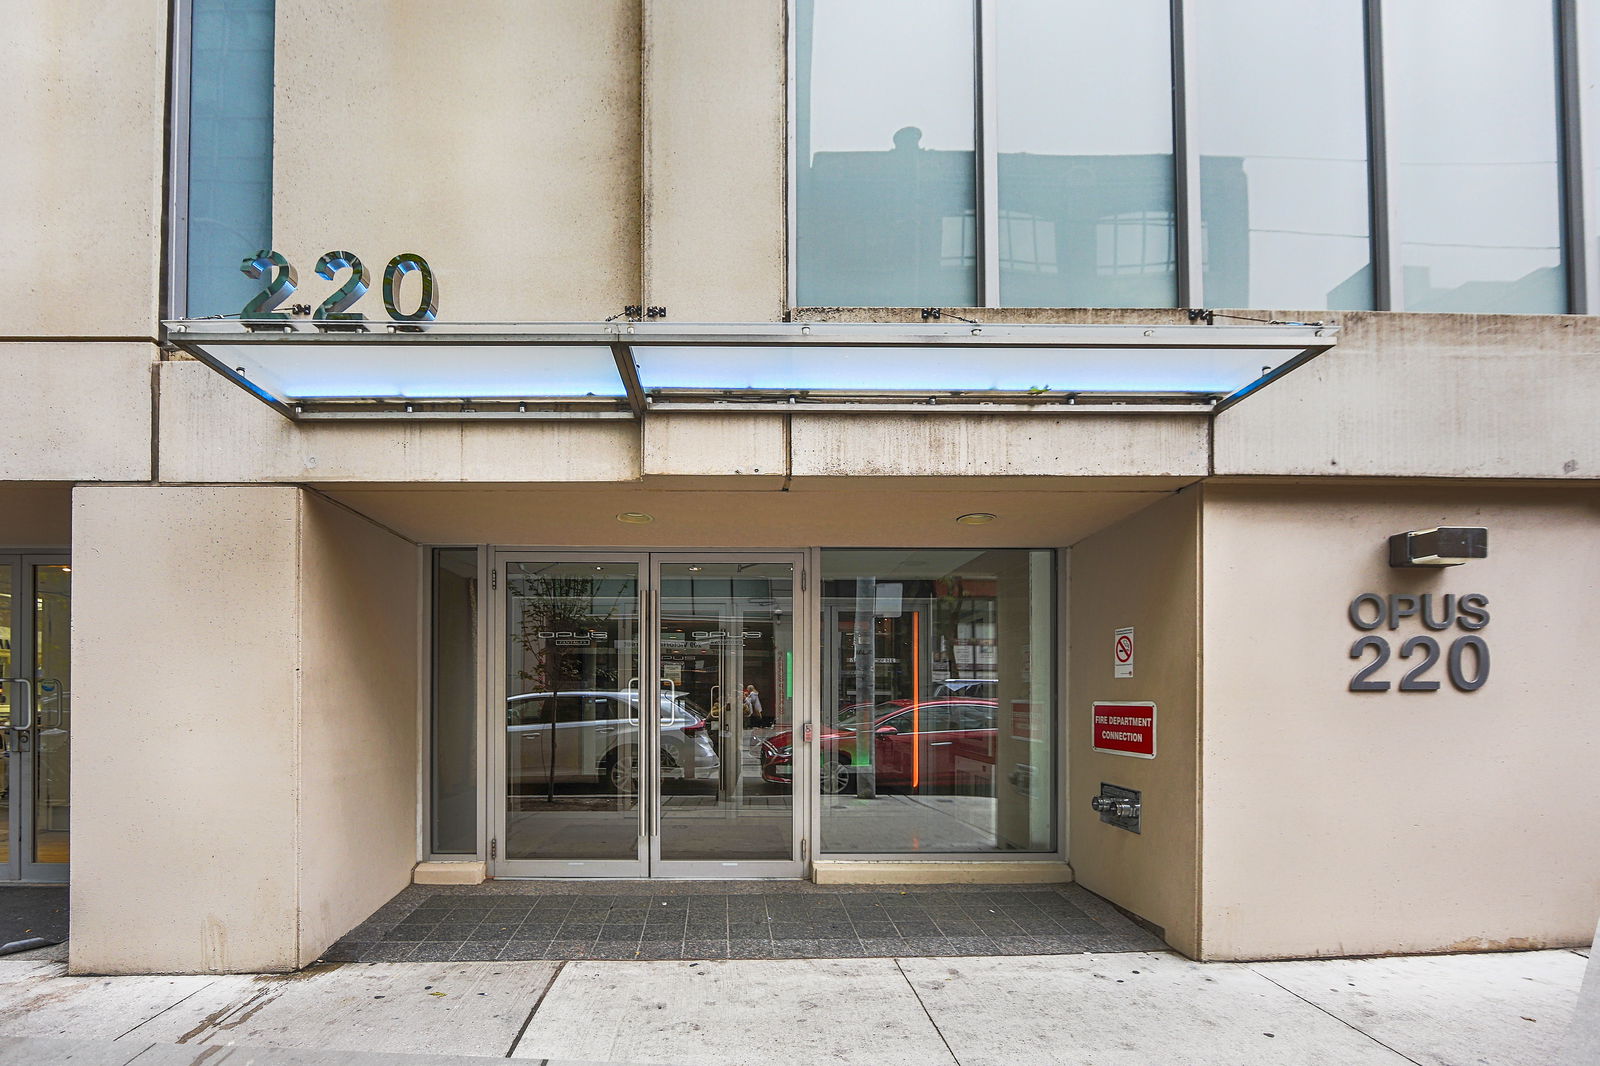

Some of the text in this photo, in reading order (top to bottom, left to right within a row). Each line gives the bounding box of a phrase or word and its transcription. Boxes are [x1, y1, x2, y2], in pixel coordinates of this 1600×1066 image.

[239, 249, 439, 331] 220
[1348, 592, 1490, 631] OPUS
[538, 631, 608, 640] OPUS
[1348, 635, 1490, 692] 220
[1095, 715, 1152, 727] FIRE DEPARTMENT
[1102, 729, 1143, 743] CONNECTION
